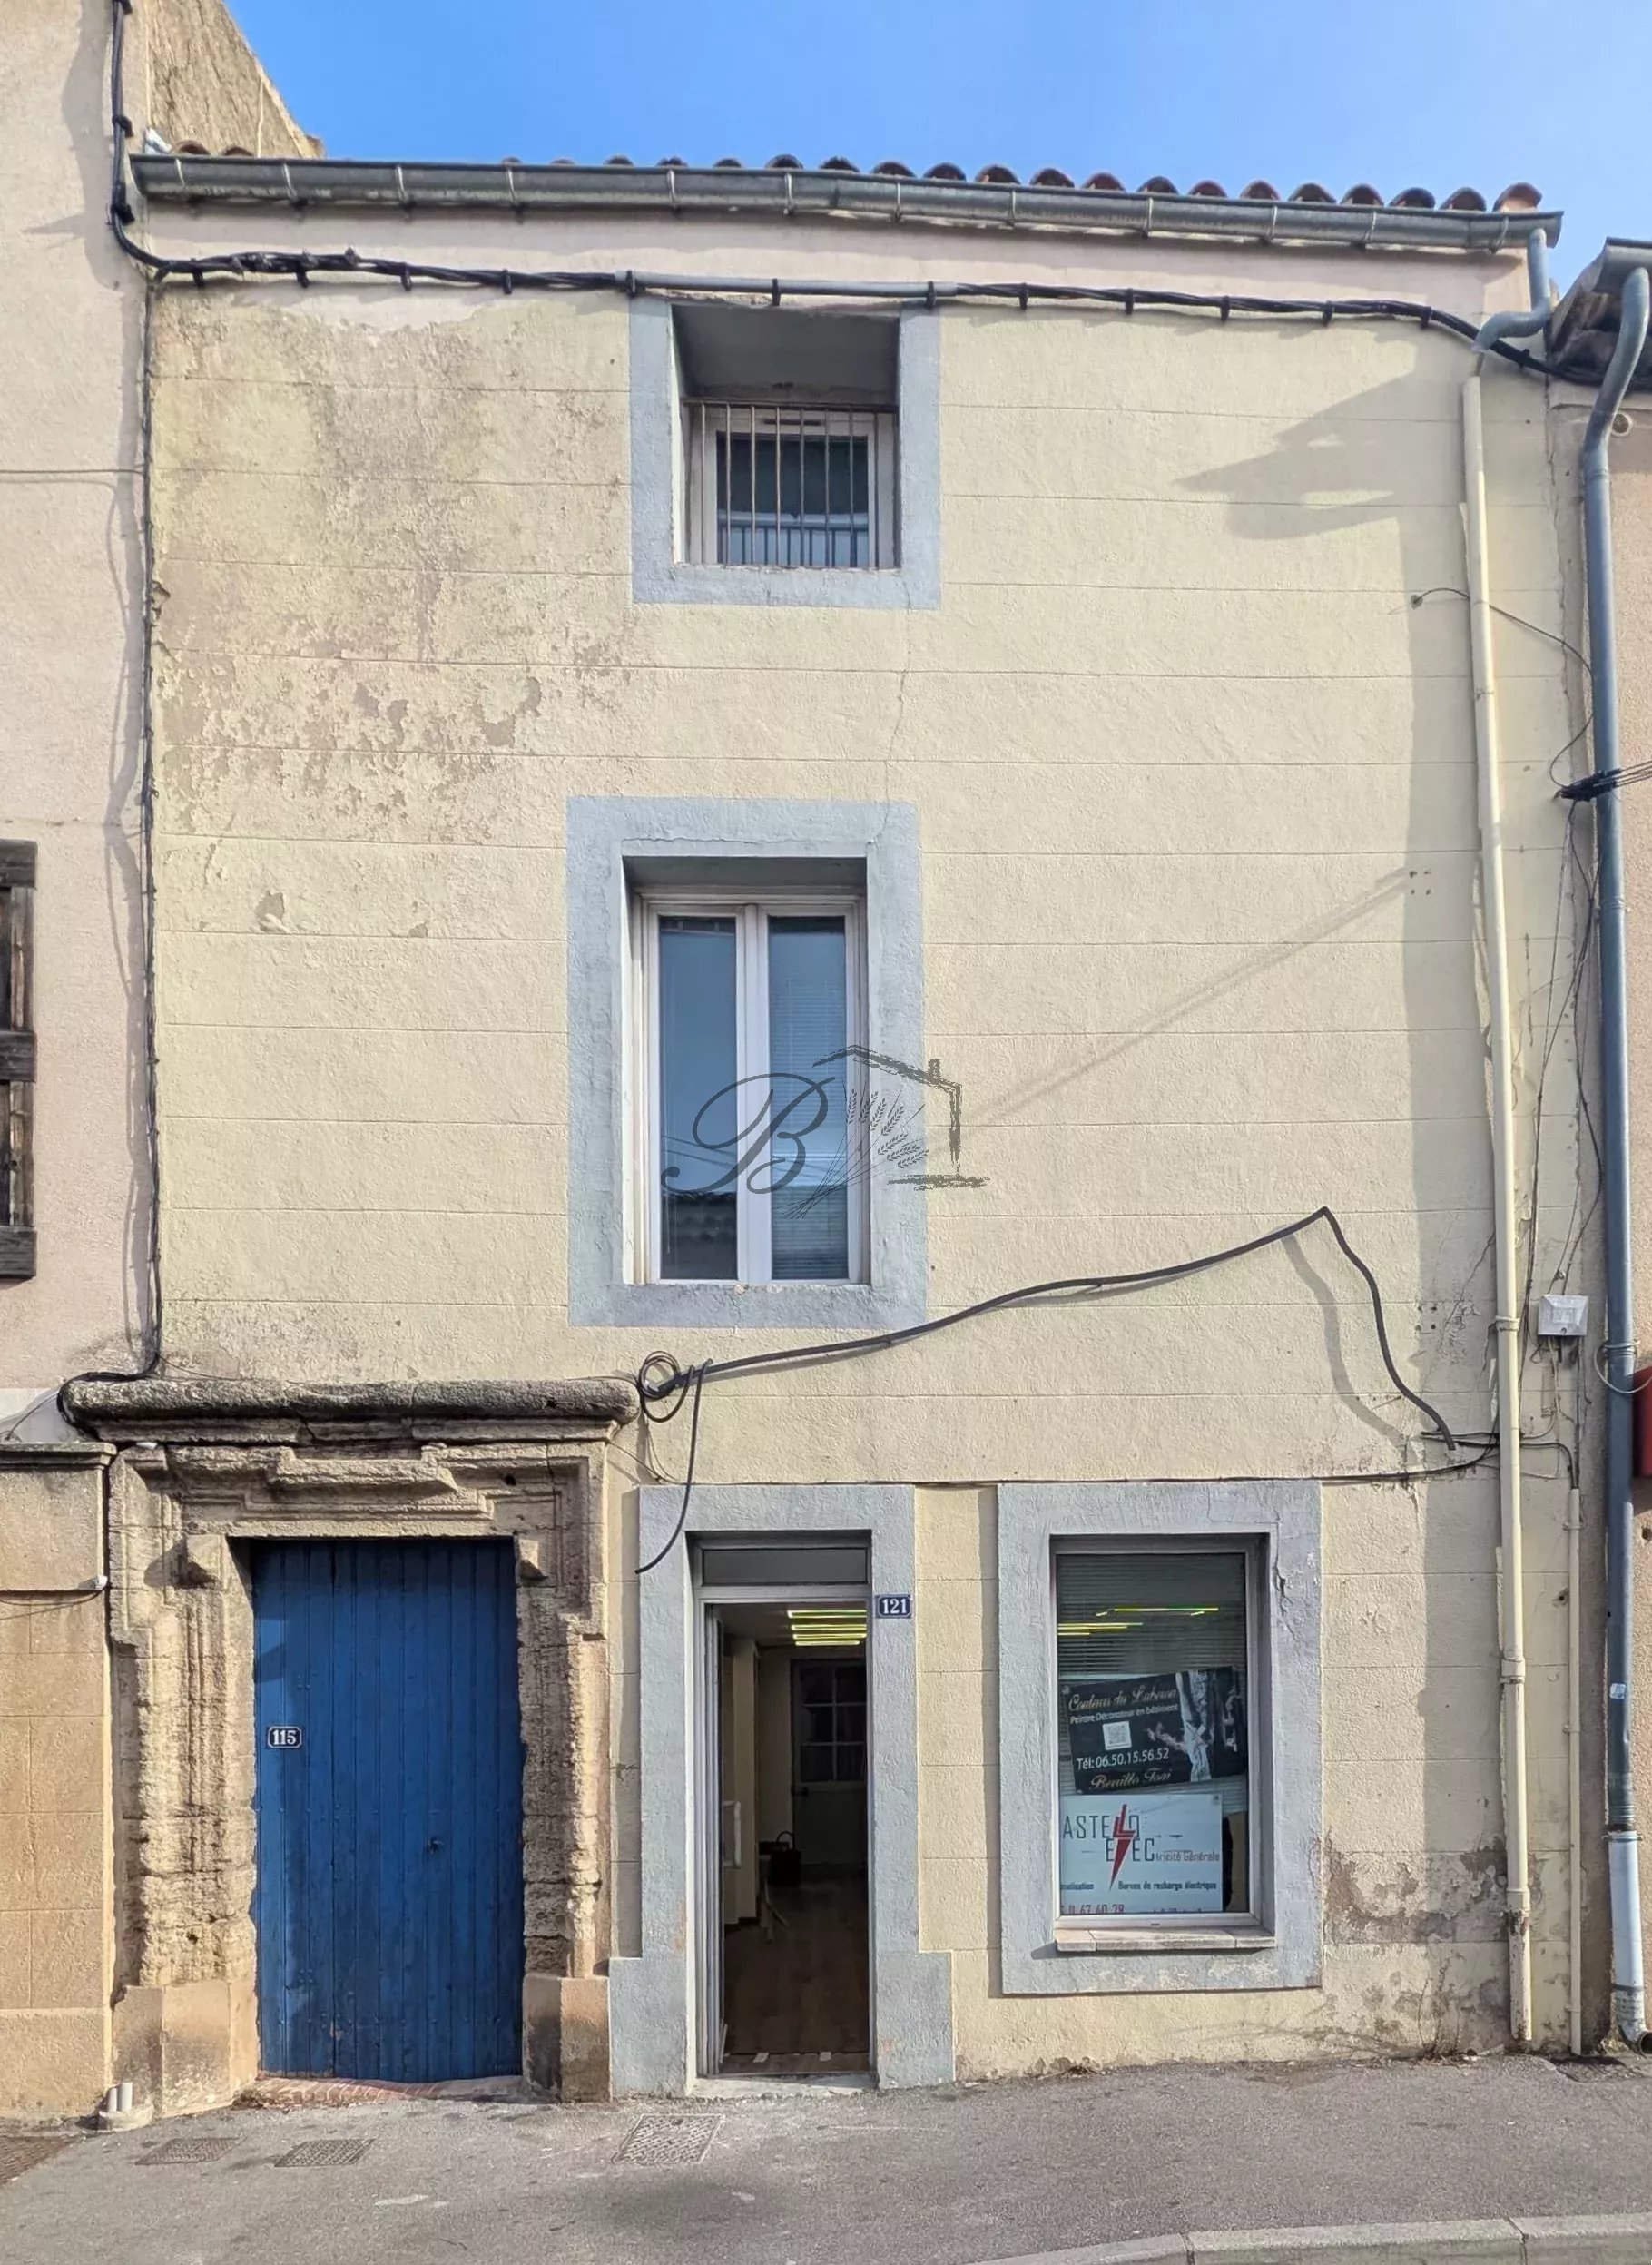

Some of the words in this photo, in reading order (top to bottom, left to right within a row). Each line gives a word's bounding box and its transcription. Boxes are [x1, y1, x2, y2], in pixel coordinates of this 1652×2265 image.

[882, 1598, 907, 1614] 121
[272, 1729, 297, 1745] 115
[1143, 1881, 1151, 1889] de
